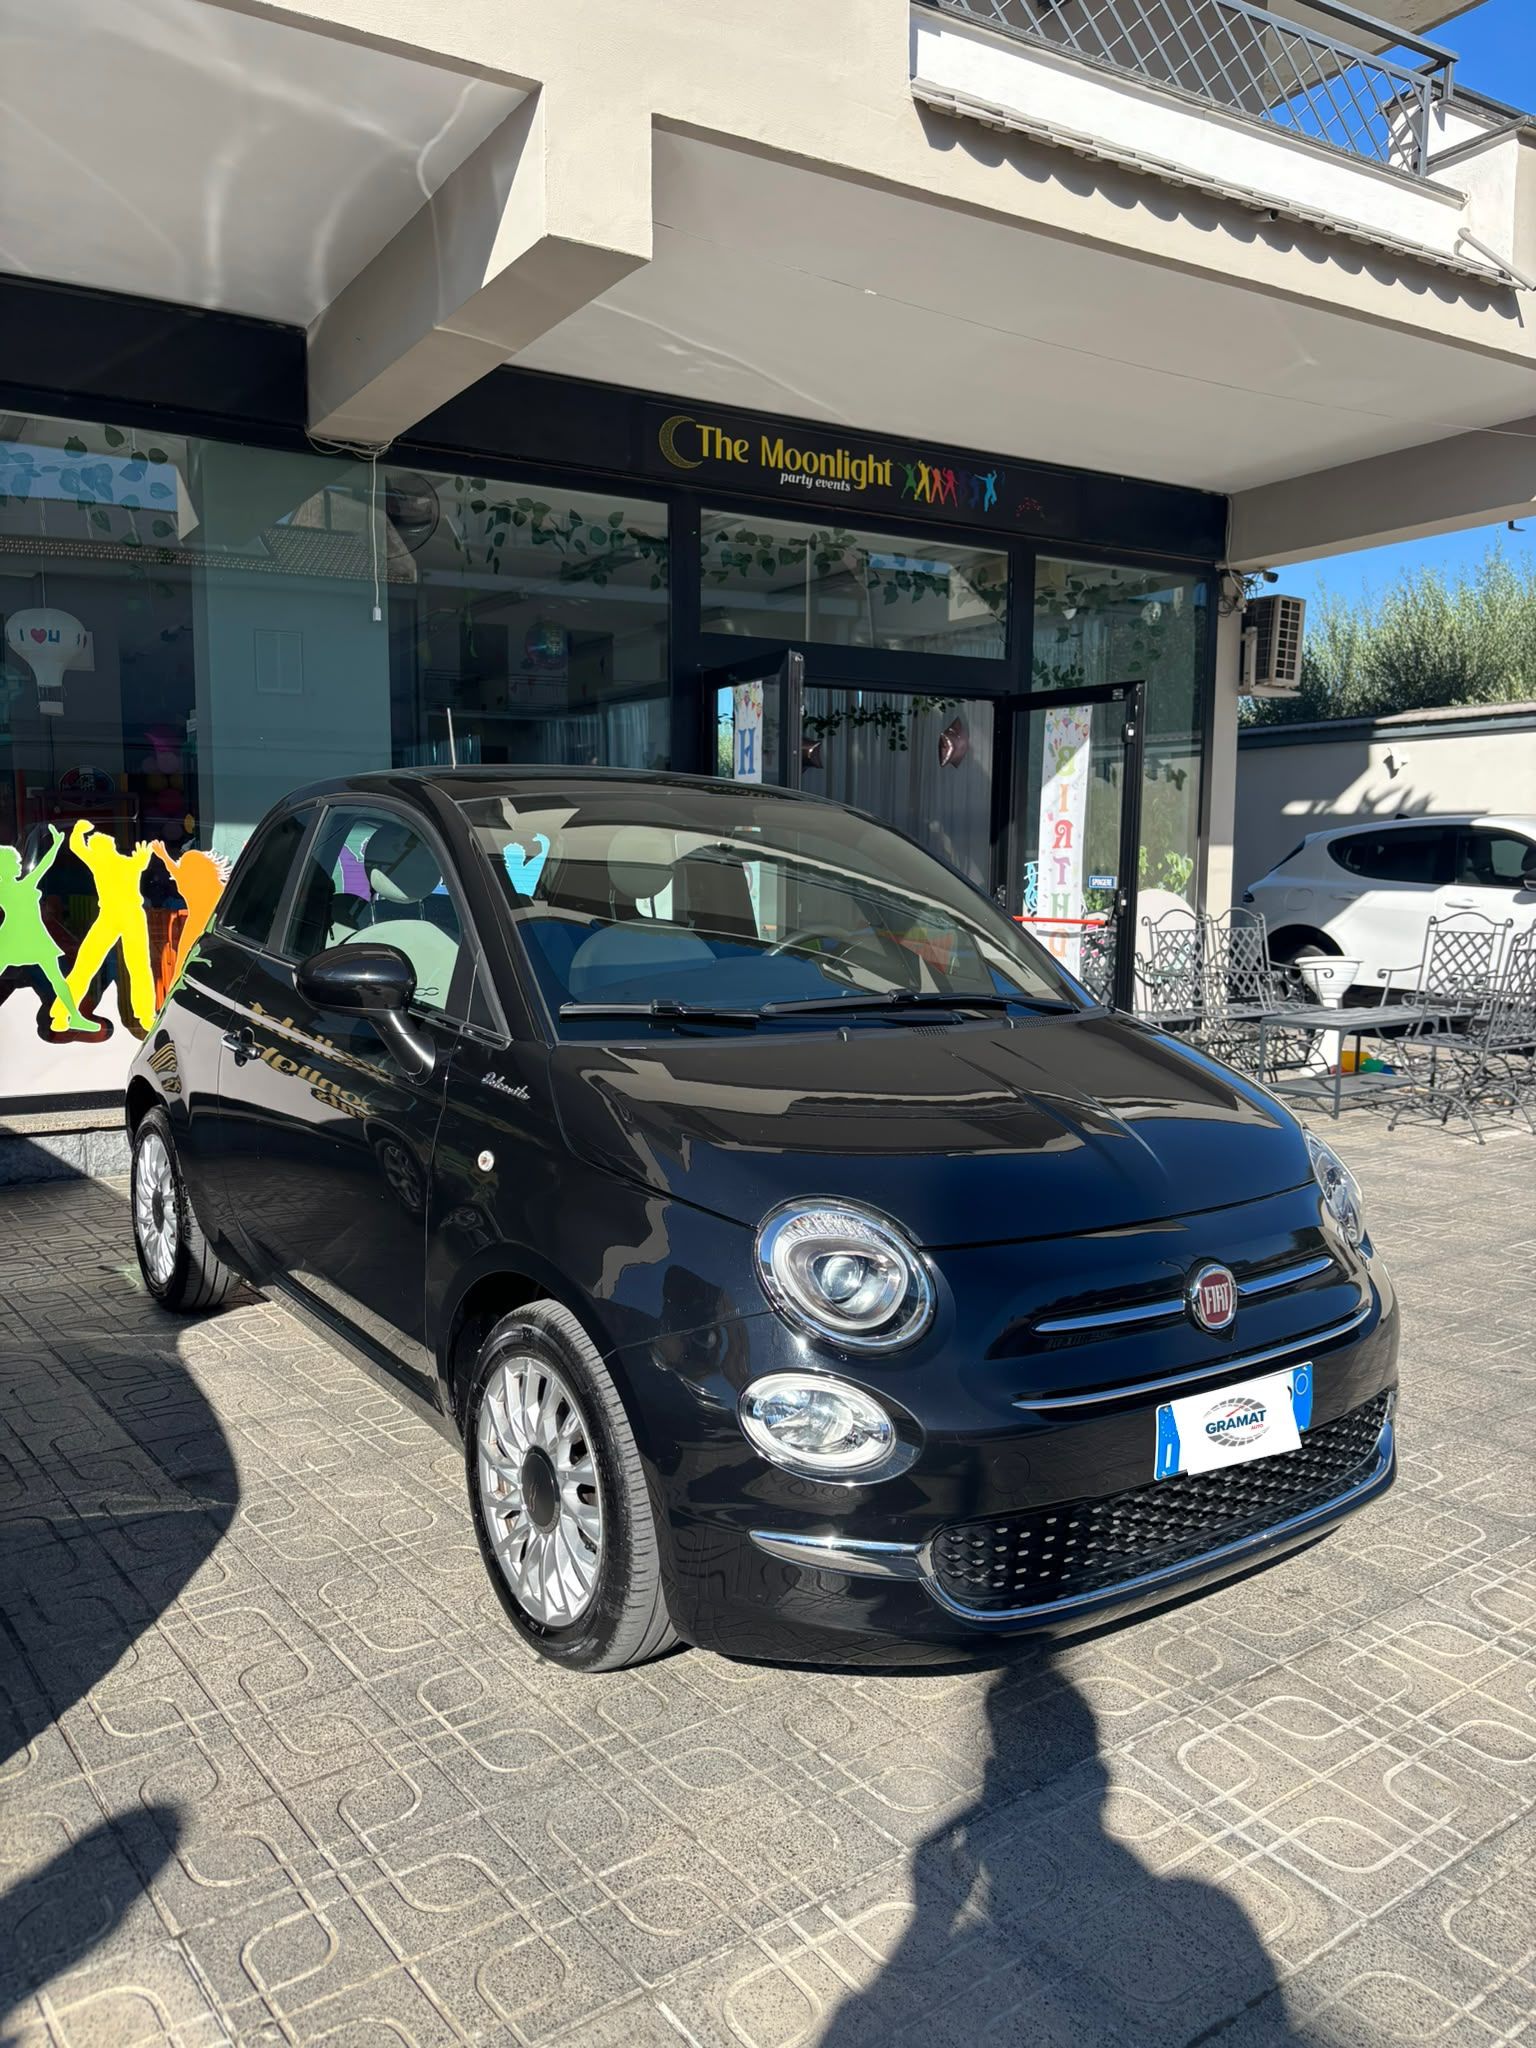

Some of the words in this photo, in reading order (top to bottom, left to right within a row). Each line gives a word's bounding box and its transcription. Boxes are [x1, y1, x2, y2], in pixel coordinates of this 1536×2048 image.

[696, 424, 749, 463] The
[760, 435, 893, 490] Moonlight
[779, 472, 813, 489] party
[815, 477, 850, 492] events
[1204, 1282, 1229, 1315] FIAT
[1205, 1409, 1267, 1434] GRAMAT
